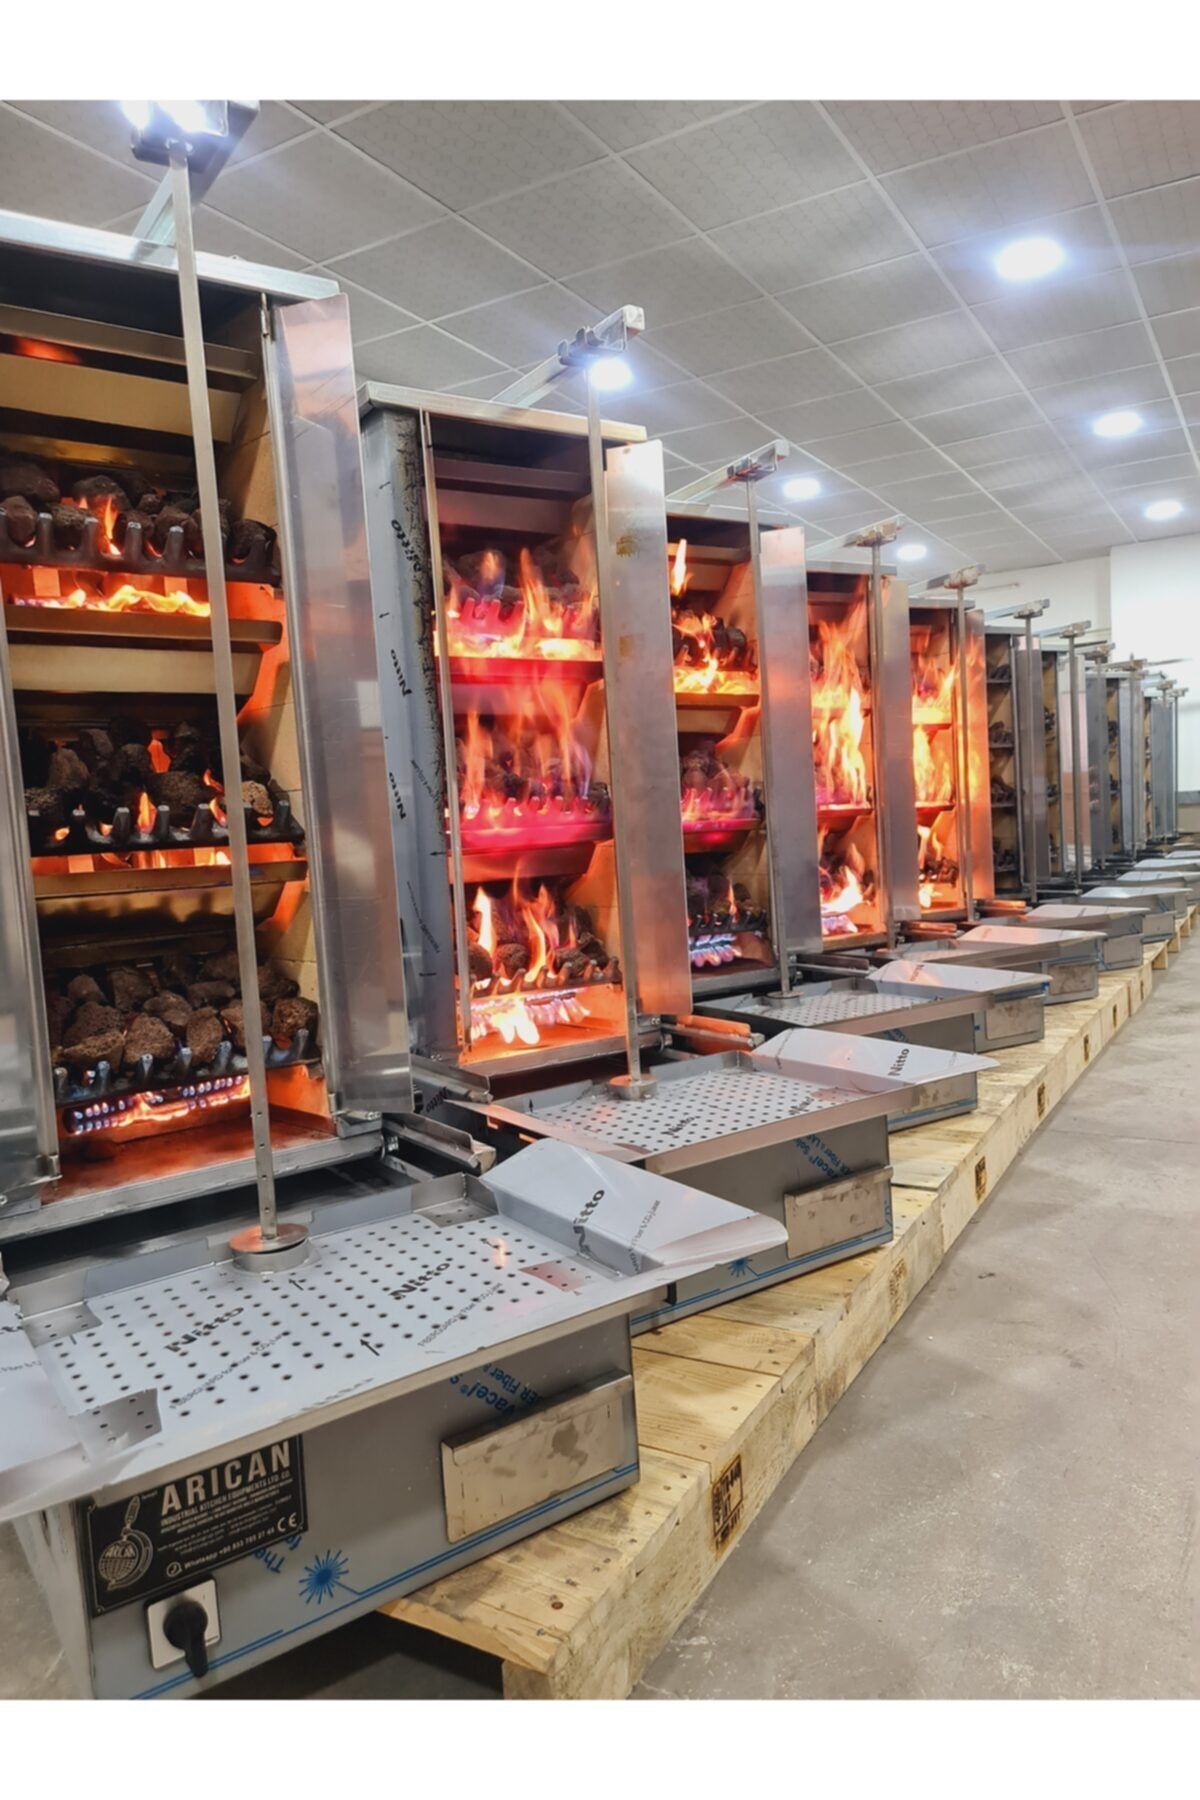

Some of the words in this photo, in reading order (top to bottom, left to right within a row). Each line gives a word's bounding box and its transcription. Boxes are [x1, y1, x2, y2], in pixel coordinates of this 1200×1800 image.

[391, 519, 422, 572] Nitto
[390, 648, 413, 698] Nitto
[388, 771, 407, 819] Nitto
[888, 1048, 910, 1077] Nitto
[389, 1263, 450, 1299] Nitto
[164, 1307, 244, 1352] Nitto
[490, 1367, 520, 1395] Fiber
[161, 1440, 290, 1517] ARICAN
[160, 1507, 199, 1527] INDUSTRIAL
[277, 1511, 298, 1532] CE
